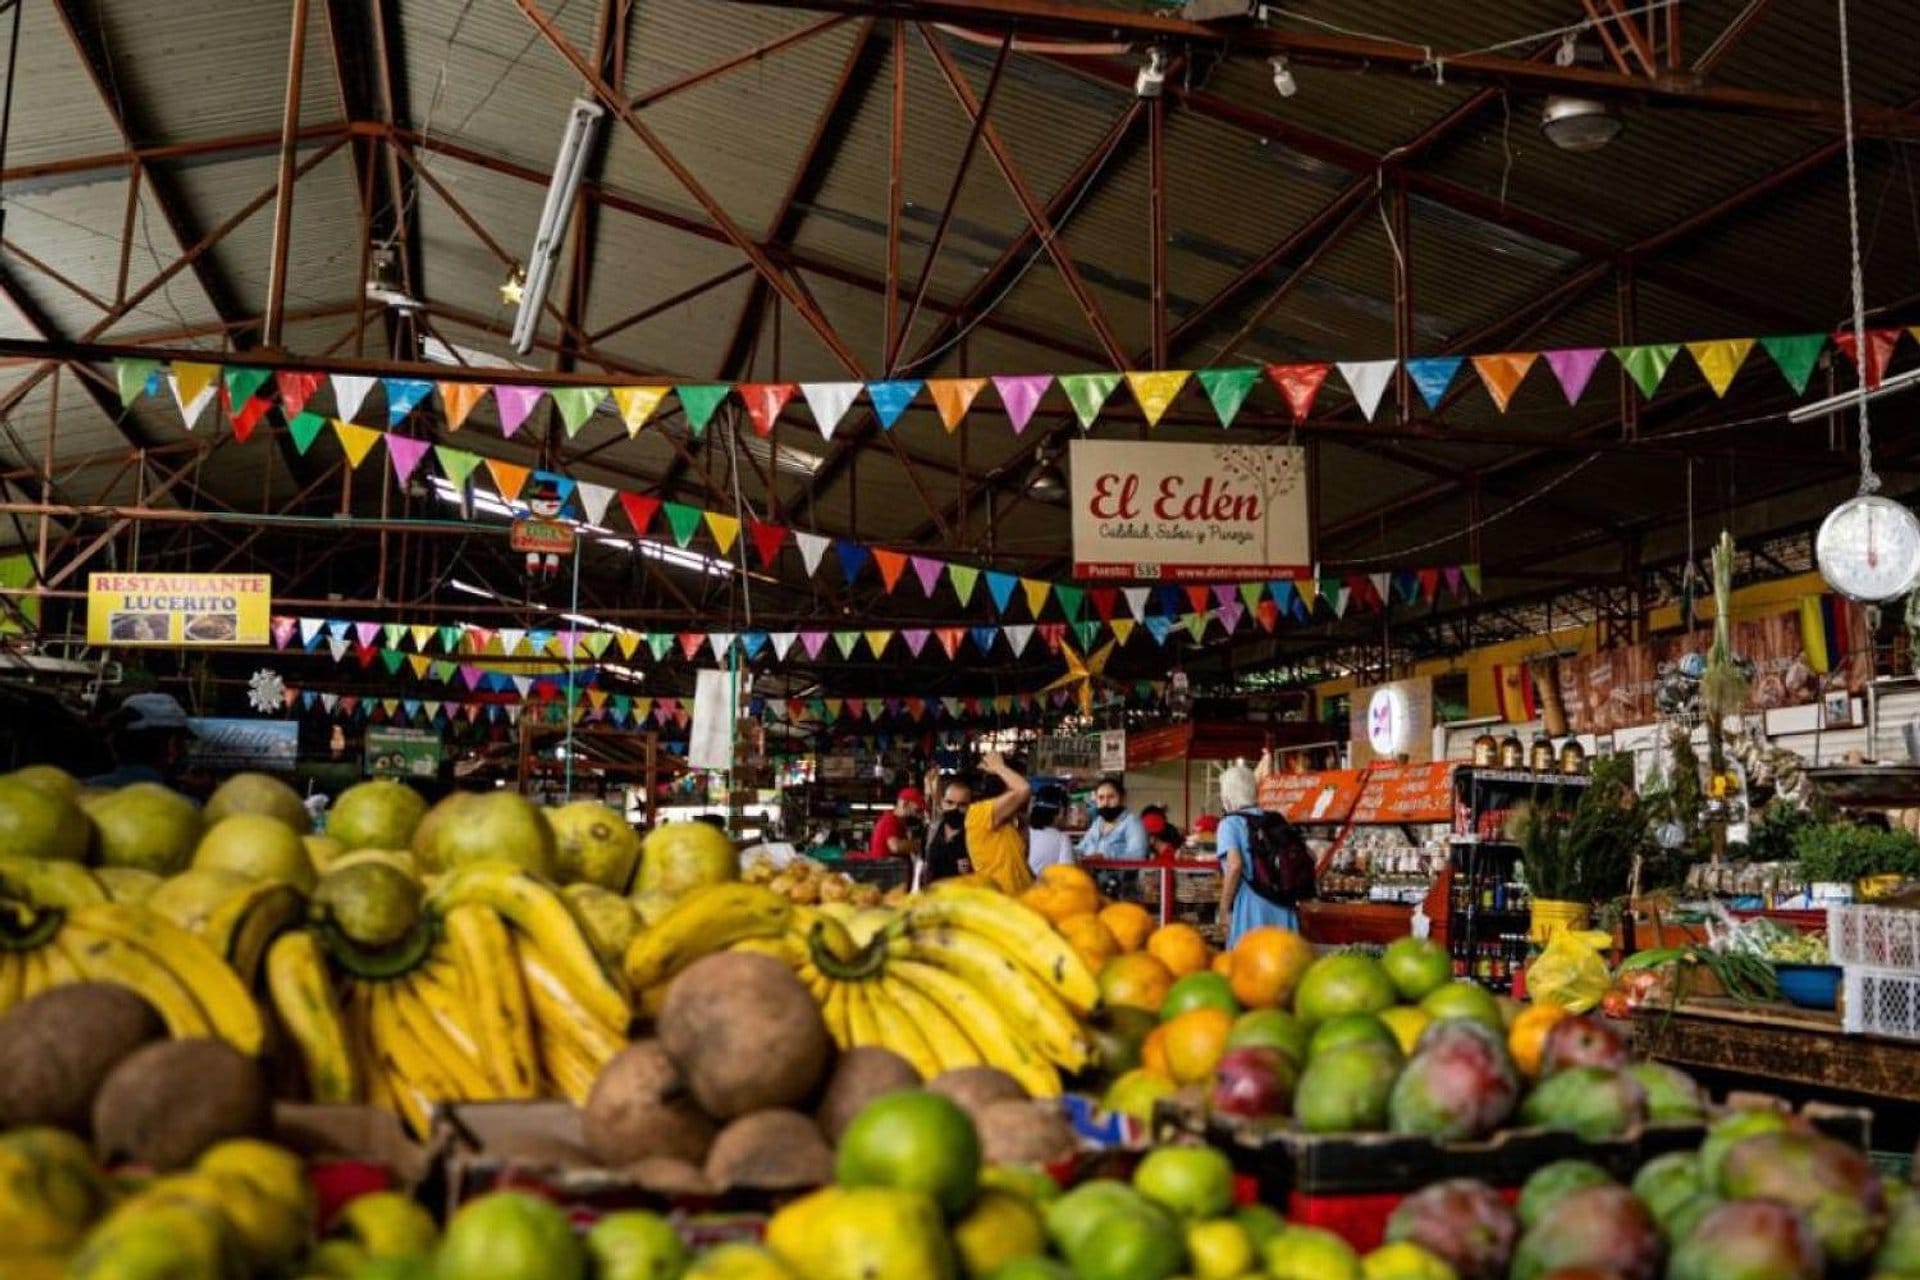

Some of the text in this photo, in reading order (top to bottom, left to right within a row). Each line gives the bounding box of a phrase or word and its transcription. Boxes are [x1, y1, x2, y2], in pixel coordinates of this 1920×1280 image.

[1090, 473, 1262, 521] El Edén
[96, 576, 265, 592] RESTAURANTE
[124, 595, 237, 610] LUCERITO
